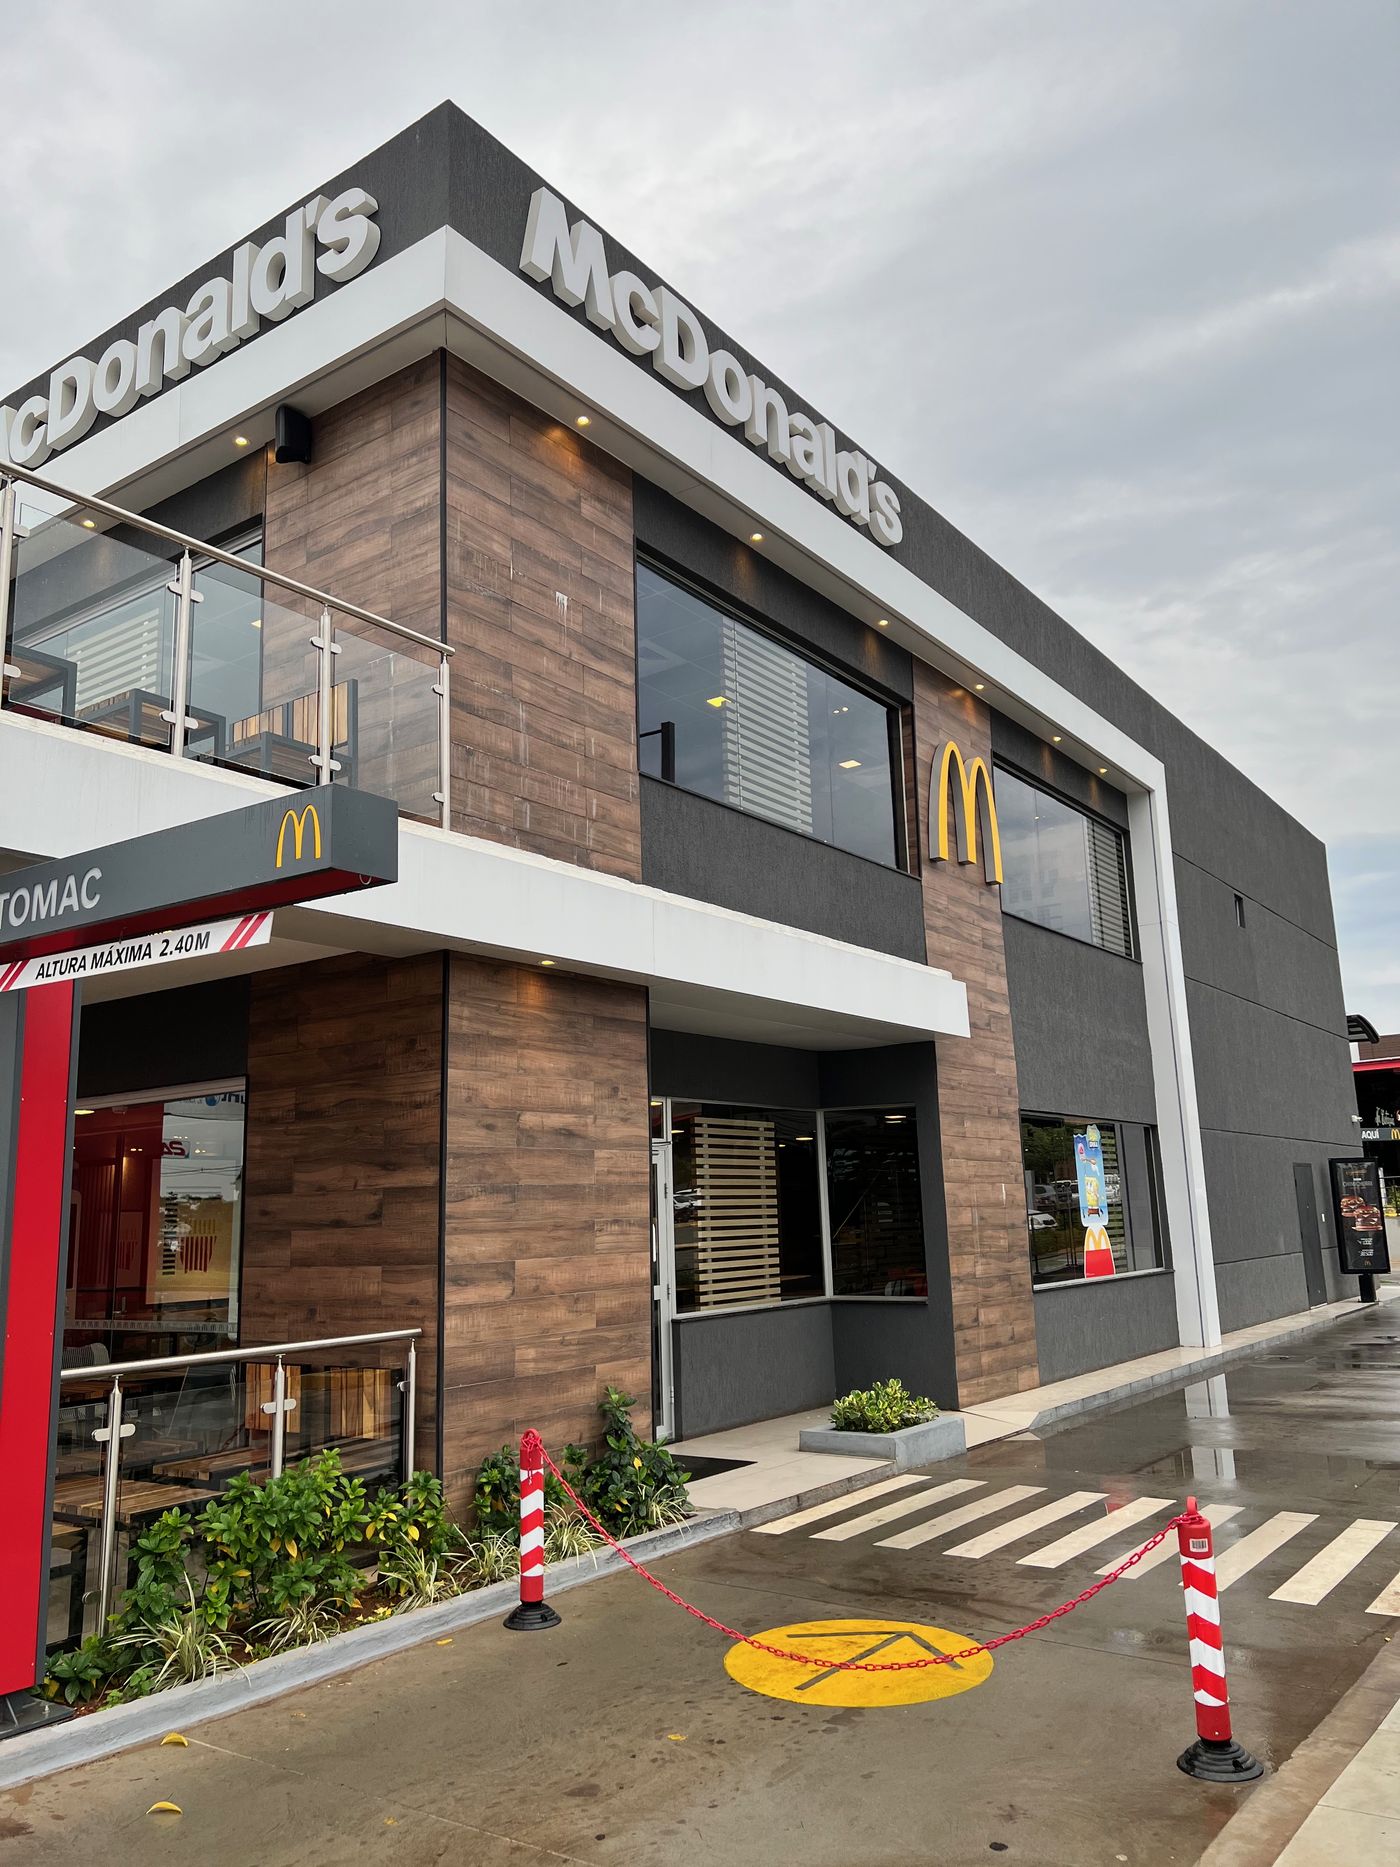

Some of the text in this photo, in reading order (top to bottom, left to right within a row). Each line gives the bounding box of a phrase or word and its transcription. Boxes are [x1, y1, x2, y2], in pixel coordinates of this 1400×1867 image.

[0, 187, 381, 468] cDonald's
[519, 186, 903, 547] McDonald's
[35, 956, 87, 980] ALTURA
[90, 944, 153, 970] MÁXIMA
